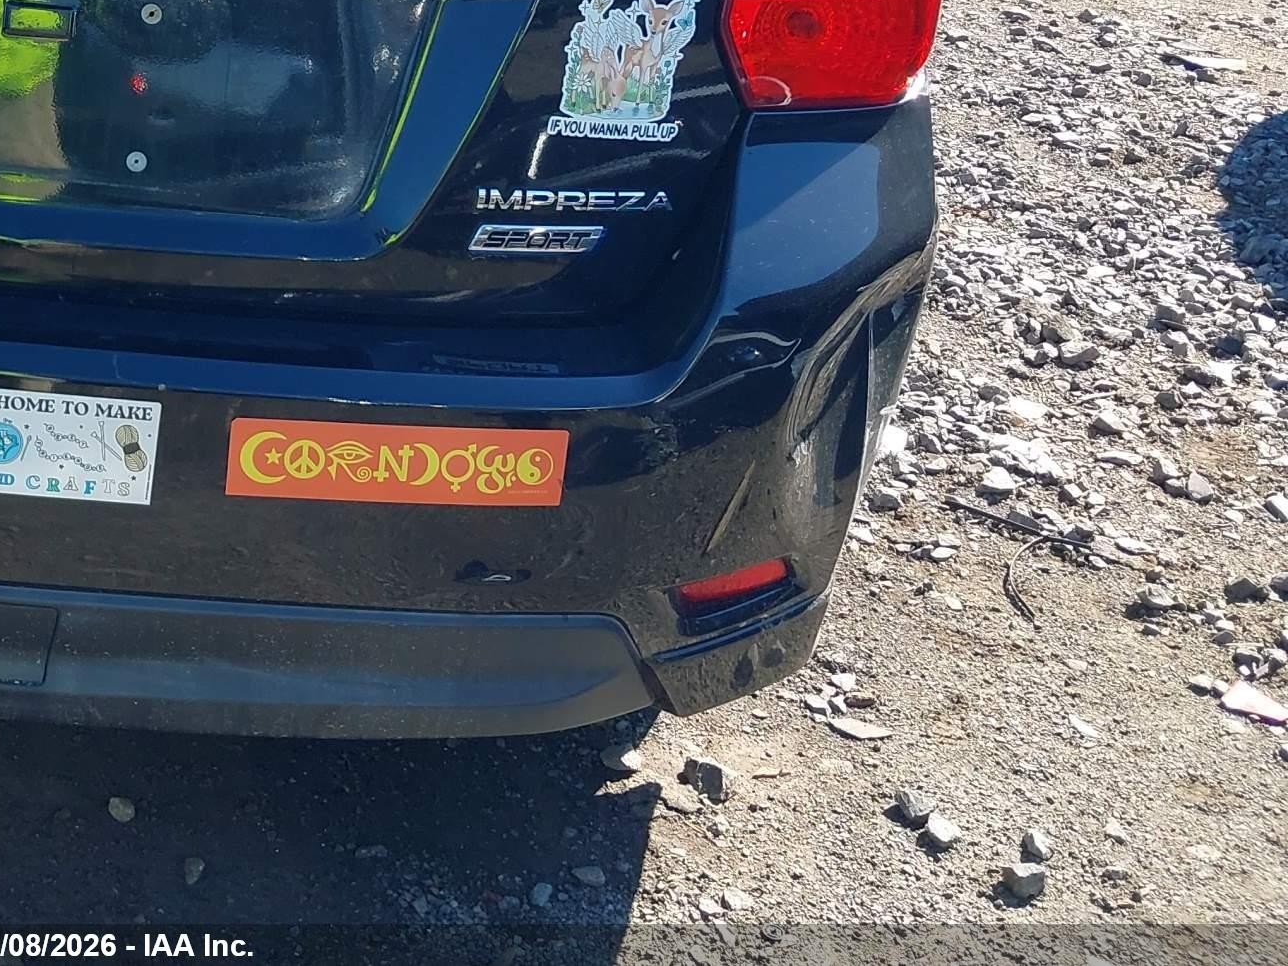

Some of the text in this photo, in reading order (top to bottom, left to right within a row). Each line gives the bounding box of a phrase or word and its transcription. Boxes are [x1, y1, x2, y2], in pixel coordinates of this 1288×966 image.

[550, 119, 677, 139] IF YOU WANNA PULL UP
[476, 188, 673, 211] IMPREZA
[483, 231, 592, 249] SPORT
[61, 400, 89, 417] TO
[94, 404, 153, 422] MAKE
[25, 474, 131, 497] CRAFTS
